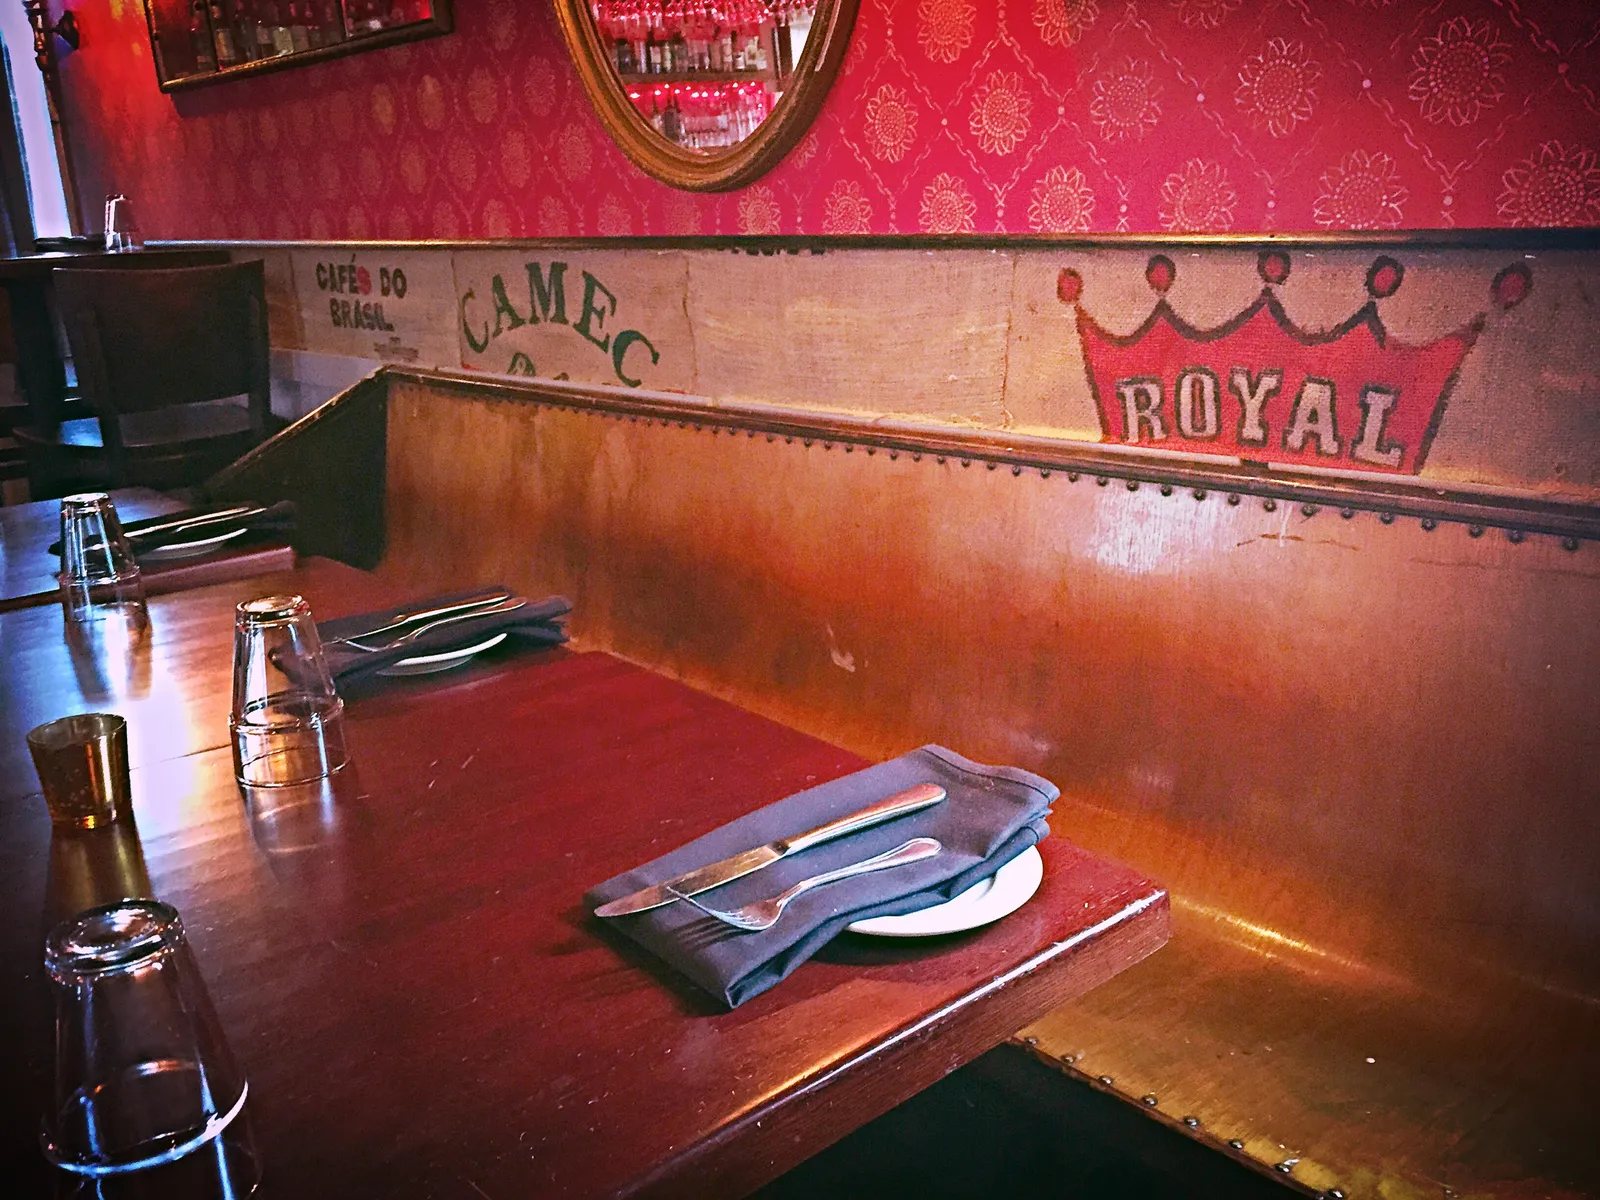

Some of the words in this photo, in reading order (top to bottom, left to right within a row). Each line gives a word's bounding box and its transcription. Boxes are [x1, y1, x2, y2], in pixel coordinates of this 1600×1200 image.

[329, 298, 395, 332] BRASIL
[379, 267, 407, 299] DO
[462, 261, 660, 388] CAMEC
[1116, 366, 1403, 467] ROYAL
